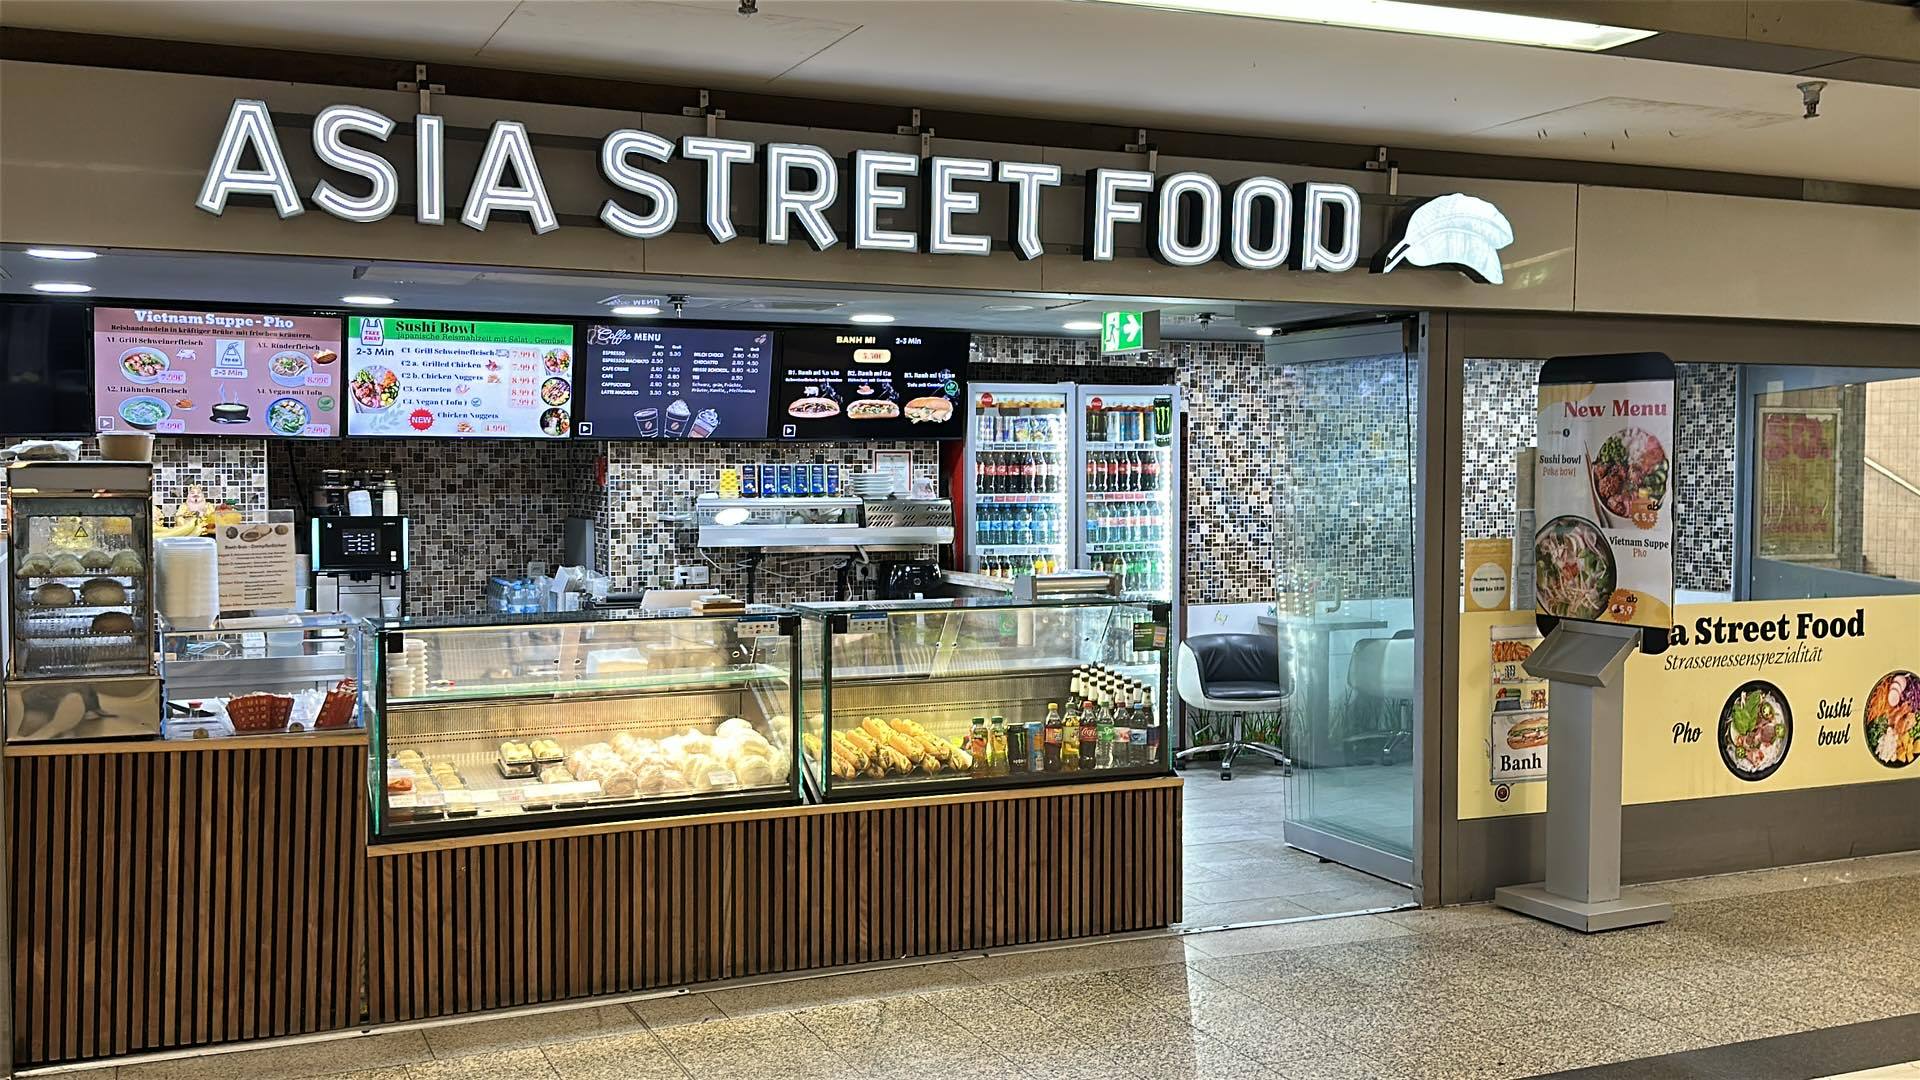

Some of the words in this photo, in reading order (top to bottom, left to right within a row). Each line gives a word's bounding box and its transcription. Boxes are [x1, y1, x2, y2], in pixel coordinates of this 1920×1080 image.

[195, 98, 559, 236] ASIA
[599, 128, 1061, 260] STREET
[1094, 167, 1360, 272] FOOD
[135, 310, 203, 325] Vietnam
[206, 313, 254, 329] Suppe
[264, 316, 295, 328] Pho
[396, 320, 436, 333] Sushi
[440, 321, 475, 335] Bowl
[397, 333, 440, 341] Japanische
[442, 334, 491, 342] Reismahlzeit
[534, 336, 565, 344] Gemüse
[597, 328, 632, 345] Coffee
[634, 333, 662, 342] MENU
[836, 336, 863, 344] BANH
[864, 336, 876, 344] MI
[895, 337, 907, 345] 2-3
[908, 337, 922, 345] Min
[272, 343, 321, 351] Rinderfleisch
[356, 347, 373, 356] 2-3
[374, 348, 395, 356] Min
[434, 348, 495, 357] Schweinefleisch
[227, 369, 243, 377] Min
[421, 373, 452, 381] Chicken
[454, 374, 484, 383] Nuggets
[120, 386, 188, 395] Hähnchenfleisch
[269, 388, 291, 396] Vegan
[416, 399, 439, 407] Vegan
[1564, 400, 1605, 419] New
[1612, 399, 1668, 418] Menu
[412, 416, 432, 424] NEW
[437, 411, 468, 419] Chicken
[470, 412, 499, 421] Nuggets
[1539, 454, 1560, 465] Sushi
[1561, 454, 1582, 465] bowl
[1543, 466, 1559, 477] Poke
[1560, 466, 1576, 478] bowl
[1609, 536, 1643, 548] Vietnam
[1644, 538, 1669, 550] Suppe
[1633, 548, 1648, 558] Pho
[1695, 613, 1790, 646] Street
[1797, 608, 1865, 640] Food
[1664, 641, 1823, 671] Strassenessenspezialität
[1816, 696, 1854, 721] Sushi
[1672, 721, 1703, 744] Pho
[1817, 724, 1852, 747] bowl
[1500, 753, 1542, 772] Banh
